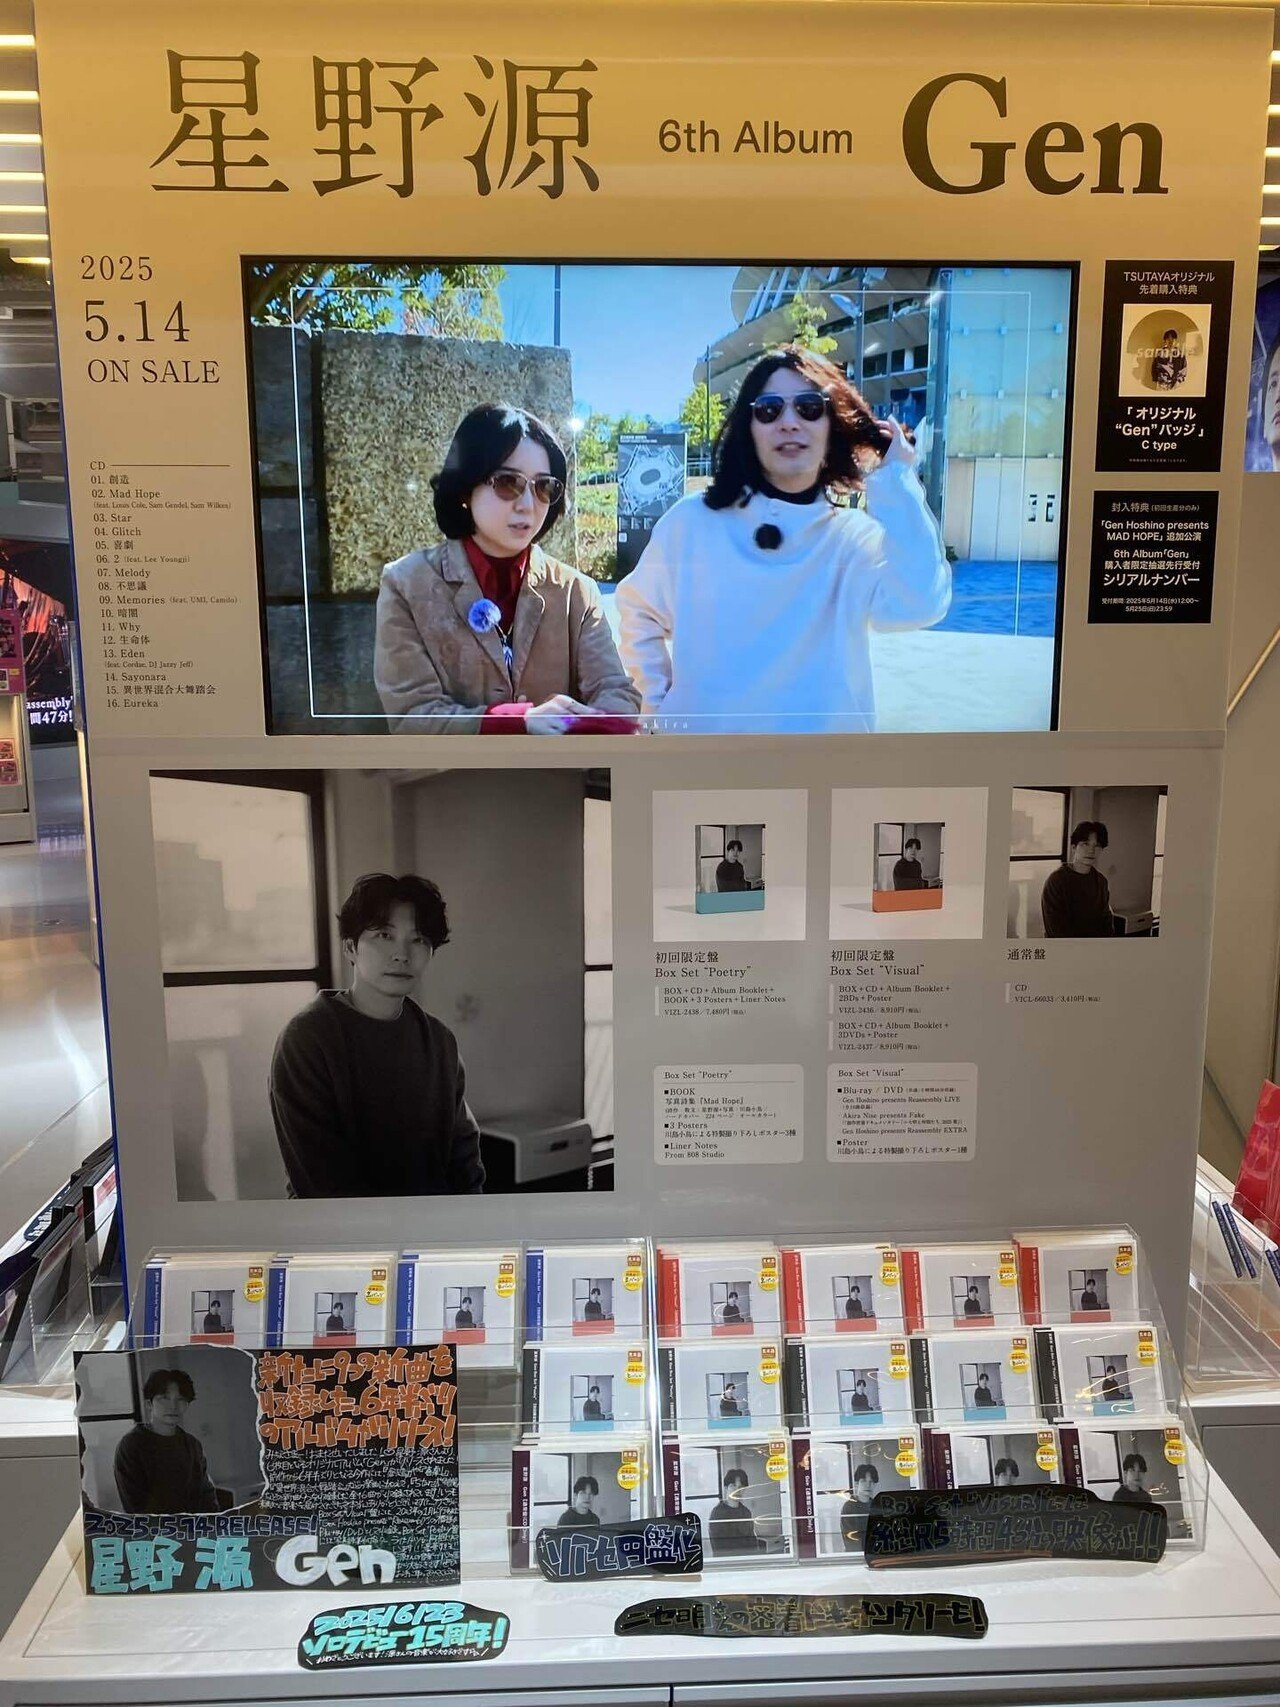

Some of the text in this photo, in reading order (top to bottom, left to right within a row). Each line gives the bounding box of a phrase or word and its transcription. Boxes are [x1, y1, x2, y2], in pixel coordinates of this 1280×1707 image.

[149, 50, 1170, 198] 星野源 6th Album Gen
[81, 255, 154, 283] 2025
[1123, 271, 1215, 282] TSUTAYAオリジナル
[1139, 284, 1198, 296] 先着購入特典
[85, 300, 190, 345] 5.14
[87, 359, 220, 385] ON SALE
[1142, 440, 1177, 451] C type
[90, 461, 105, 471] CD
[91, 476, 104, 485] 01.
[92, 489, 160, 500] 02. Mad Hope
[93, 514, 132, 523] 03. Star
[1126, 520, 1165, 530] Hoshino
[1167, 521, 1209, 531] presents
[94, 527, 141, 536] 04. Glitch
[1106, 532, 1130, 541] MAD
[1166, 532, 1202, 542] 追加公演
[95, 541, 109, 550] 05.
[1113, 549, 1130, 558] 6th
[96, 555, 109, 563] 06.
[113, 555, 120, 563] 2
[97, 568, 150, 579] 07. Melody
[1103, 573, 1200, 586] シリアルナンバー
[98, 581, 147, 591] 08. 不思議
[99, 595, 112, 604] 09.
[117, 595, 165, 605] Memories
[101, 609, 113, 618] 10.
[102, 622, 141, 632] 11. Why
[103, 635, 150, 645] 12. 生命体
[104, 649, 145, 658] 13. Eden
[105, 672, 166, 682] 14. Sayonara
[106, 686, 119, 695] 15.
[107, 699, 158, 708] 16. Eureka
[655, 951, 719, 963] 初回限定盤
[831, 948, 1046, 962] 初回限定盤 通常盤
[655, 968, 676, 978] Box
[681, 967, 699, 978] Set
[830, 965, 852, 976] Box
[857, 965, 874, 976] Set
[1015, 984, 1028, 992] CD
[764, 995, 786, 1003] Notes
[664, 1071, 680, 1079] Box
[682, 1071, 696, 1079] Set
[838, 1070, 854, 1078] Box
[843, 1086, 873, 1095] Blu-ray
[883, 1086, 904, 1094] DVD
[670, 1142, 718, 1150] Liner Notes
[842, 1139, 868, 1147] Poster
[257, 1344, 454, 1389] 新たに9つの新曲を
[275, 1534, 397, 1586] Gen
[313, 1601, 466, 1636] 2025/6/23
[302, 1616, 507, 1657] ソロデビュー15周年!
